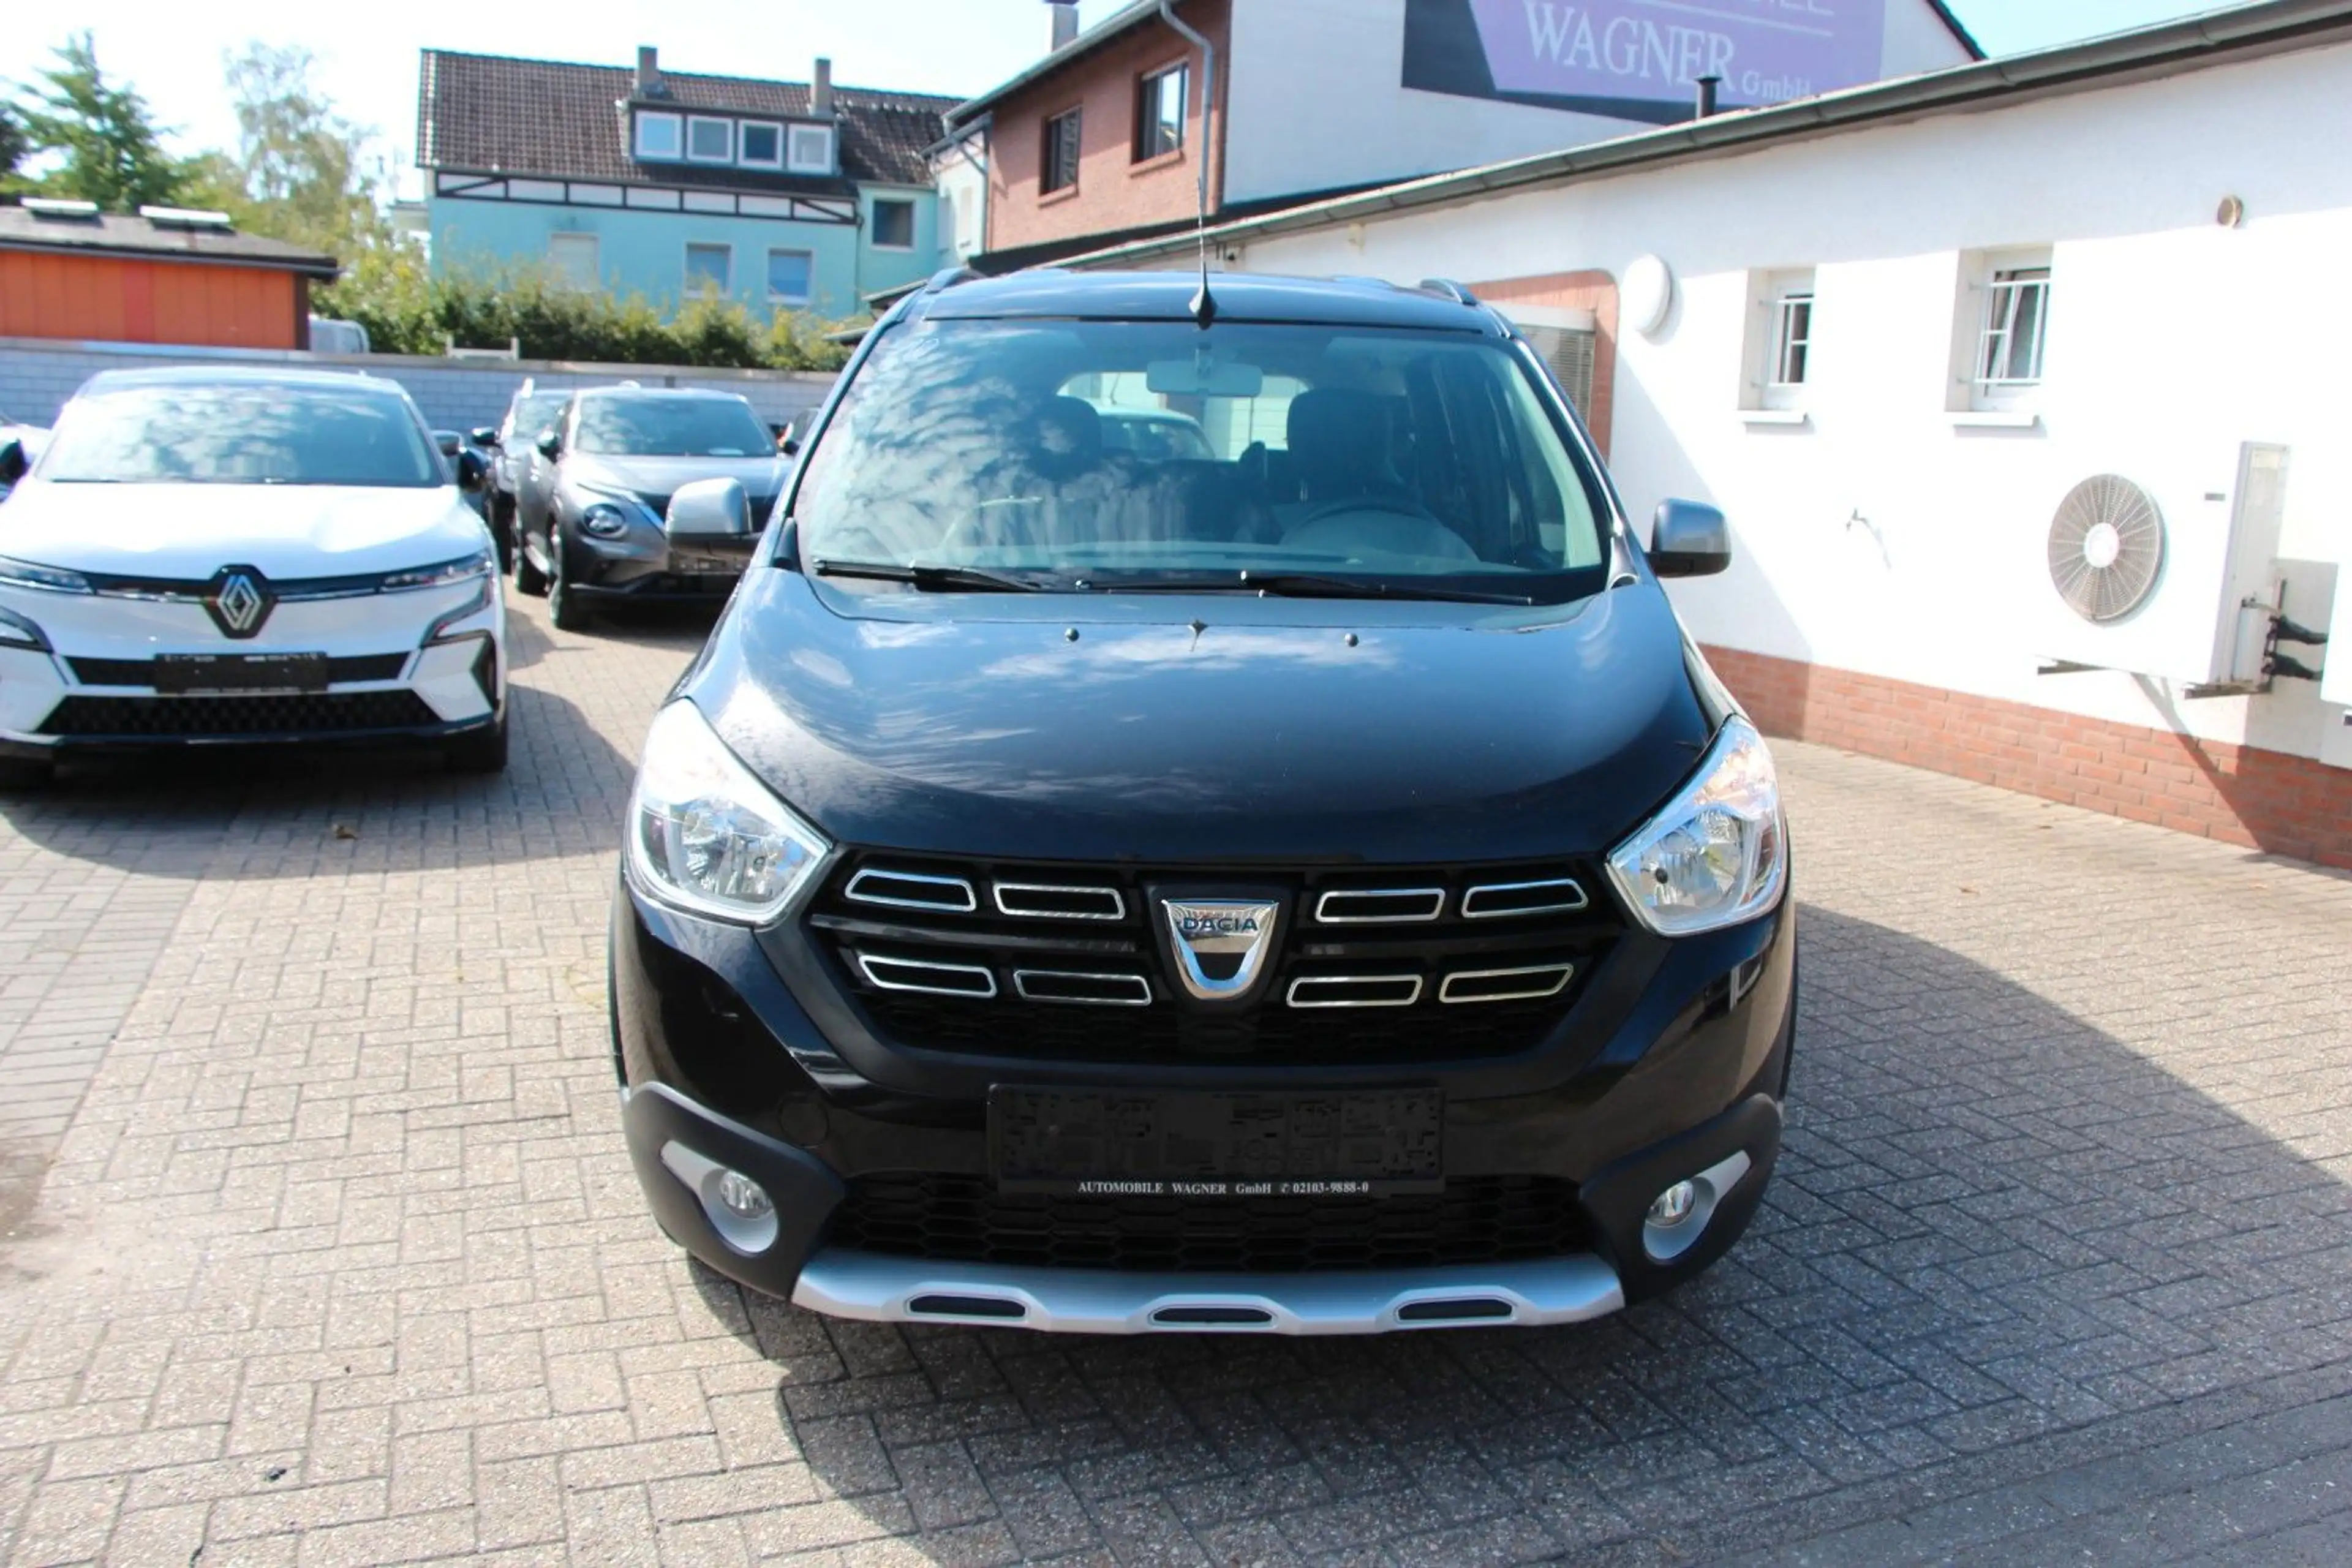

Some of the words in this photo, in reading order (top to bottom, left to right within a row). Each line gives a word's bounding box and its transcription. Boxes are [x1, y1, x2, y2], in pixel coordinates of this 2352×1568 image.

[1523, 0, 1736, 92] WAGNER
[1742, 70, 1811, 100] GmbH
[1183, 918, 1258, 932] DACIA
[1077, 1181, 1164, 1194] AUTOMOBILE
[1171, 1182, 1227, 1194] WAGNER
[1235, 1182, 1272, 1194] GmbH
